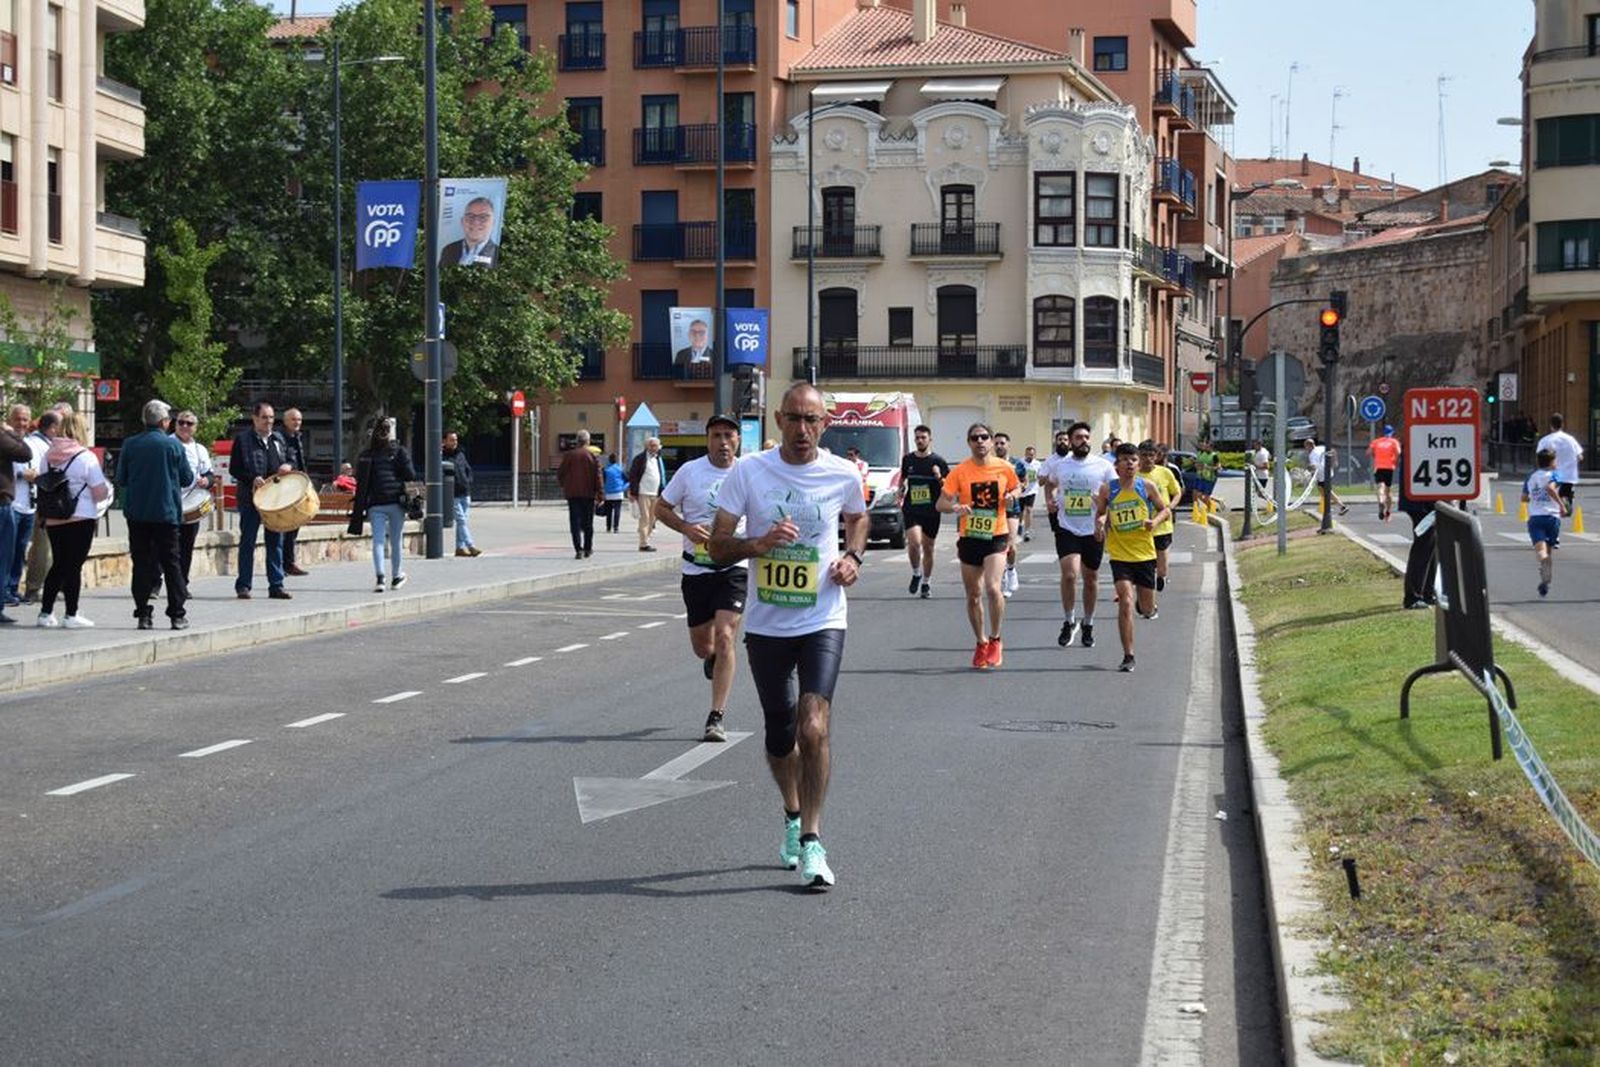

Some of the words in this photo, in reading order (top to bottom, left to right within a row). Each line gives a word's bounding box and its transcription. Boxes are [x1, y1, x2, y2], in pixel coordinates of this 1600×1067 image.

[366, 204, 405, 217] VOTA
[734, 322, 760, 332] VOTA
[1411, 398, 1473, 419] N-122
[1427, 433, 1457, 449] km
[1412, 458, 1473, 487] 459
[1069, 497, 1084, 509] 74
[1116, 509, 1136, 523] 171
[969, 517, 992, 531] 159
[763, 562, 808, 589] 106
